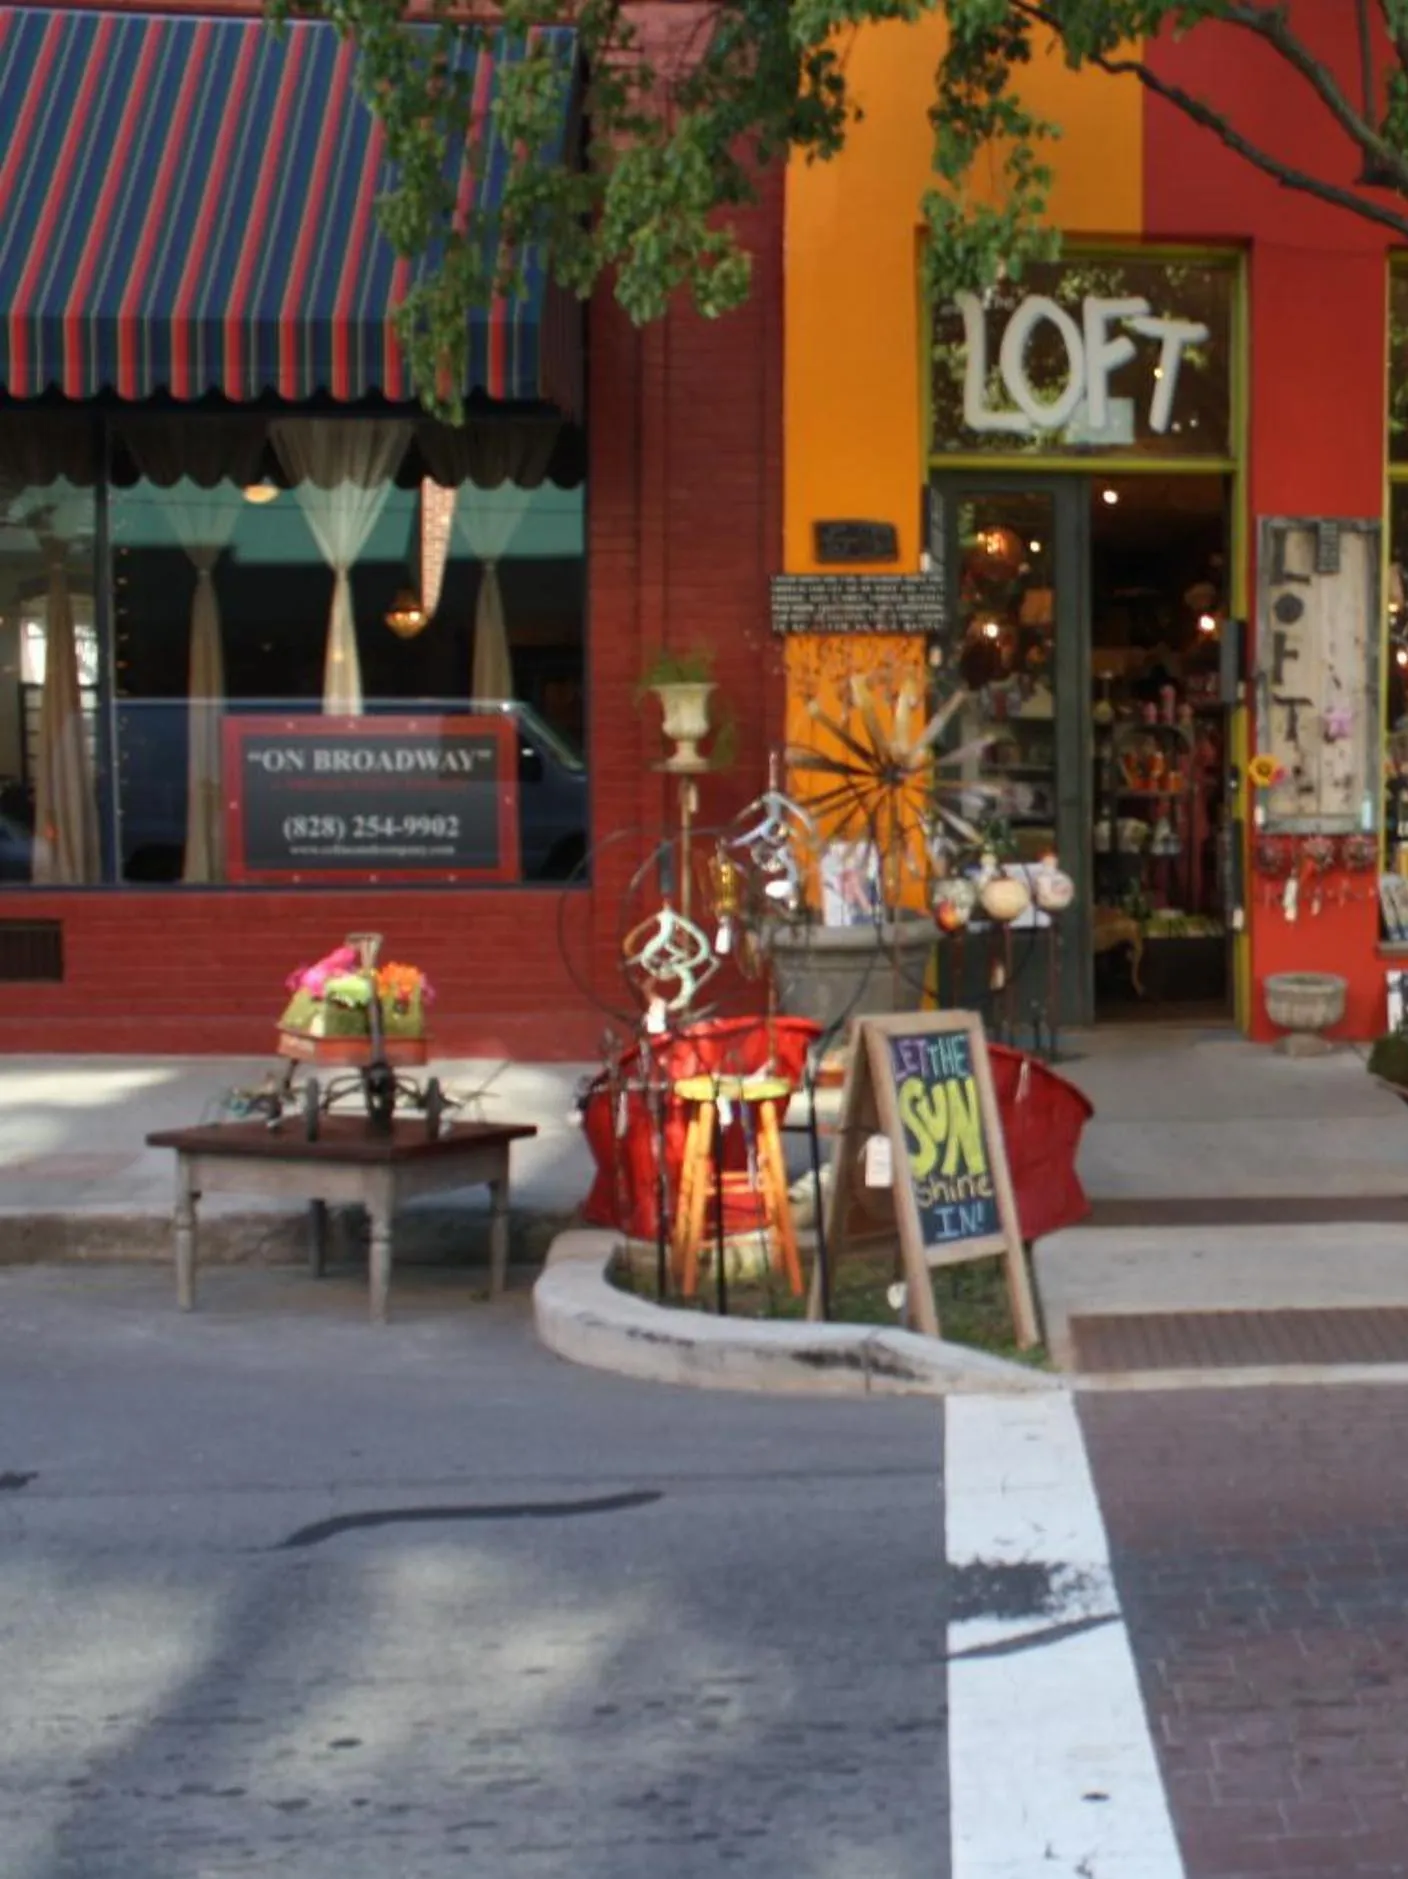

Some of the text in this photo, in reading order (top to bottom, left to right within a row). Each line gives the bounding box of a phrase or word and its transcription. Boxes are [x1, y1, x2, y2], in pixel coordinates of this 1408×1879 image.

[954, 292, 1210, 434] LOFT
[248, 749, 491, 773] "ON BROADWAY"
[283, 814, 459, 840] (828) 254-9902
[896, 1034, 968, 1081] LET THE
[900, 1078, 985, 1177] SUN
